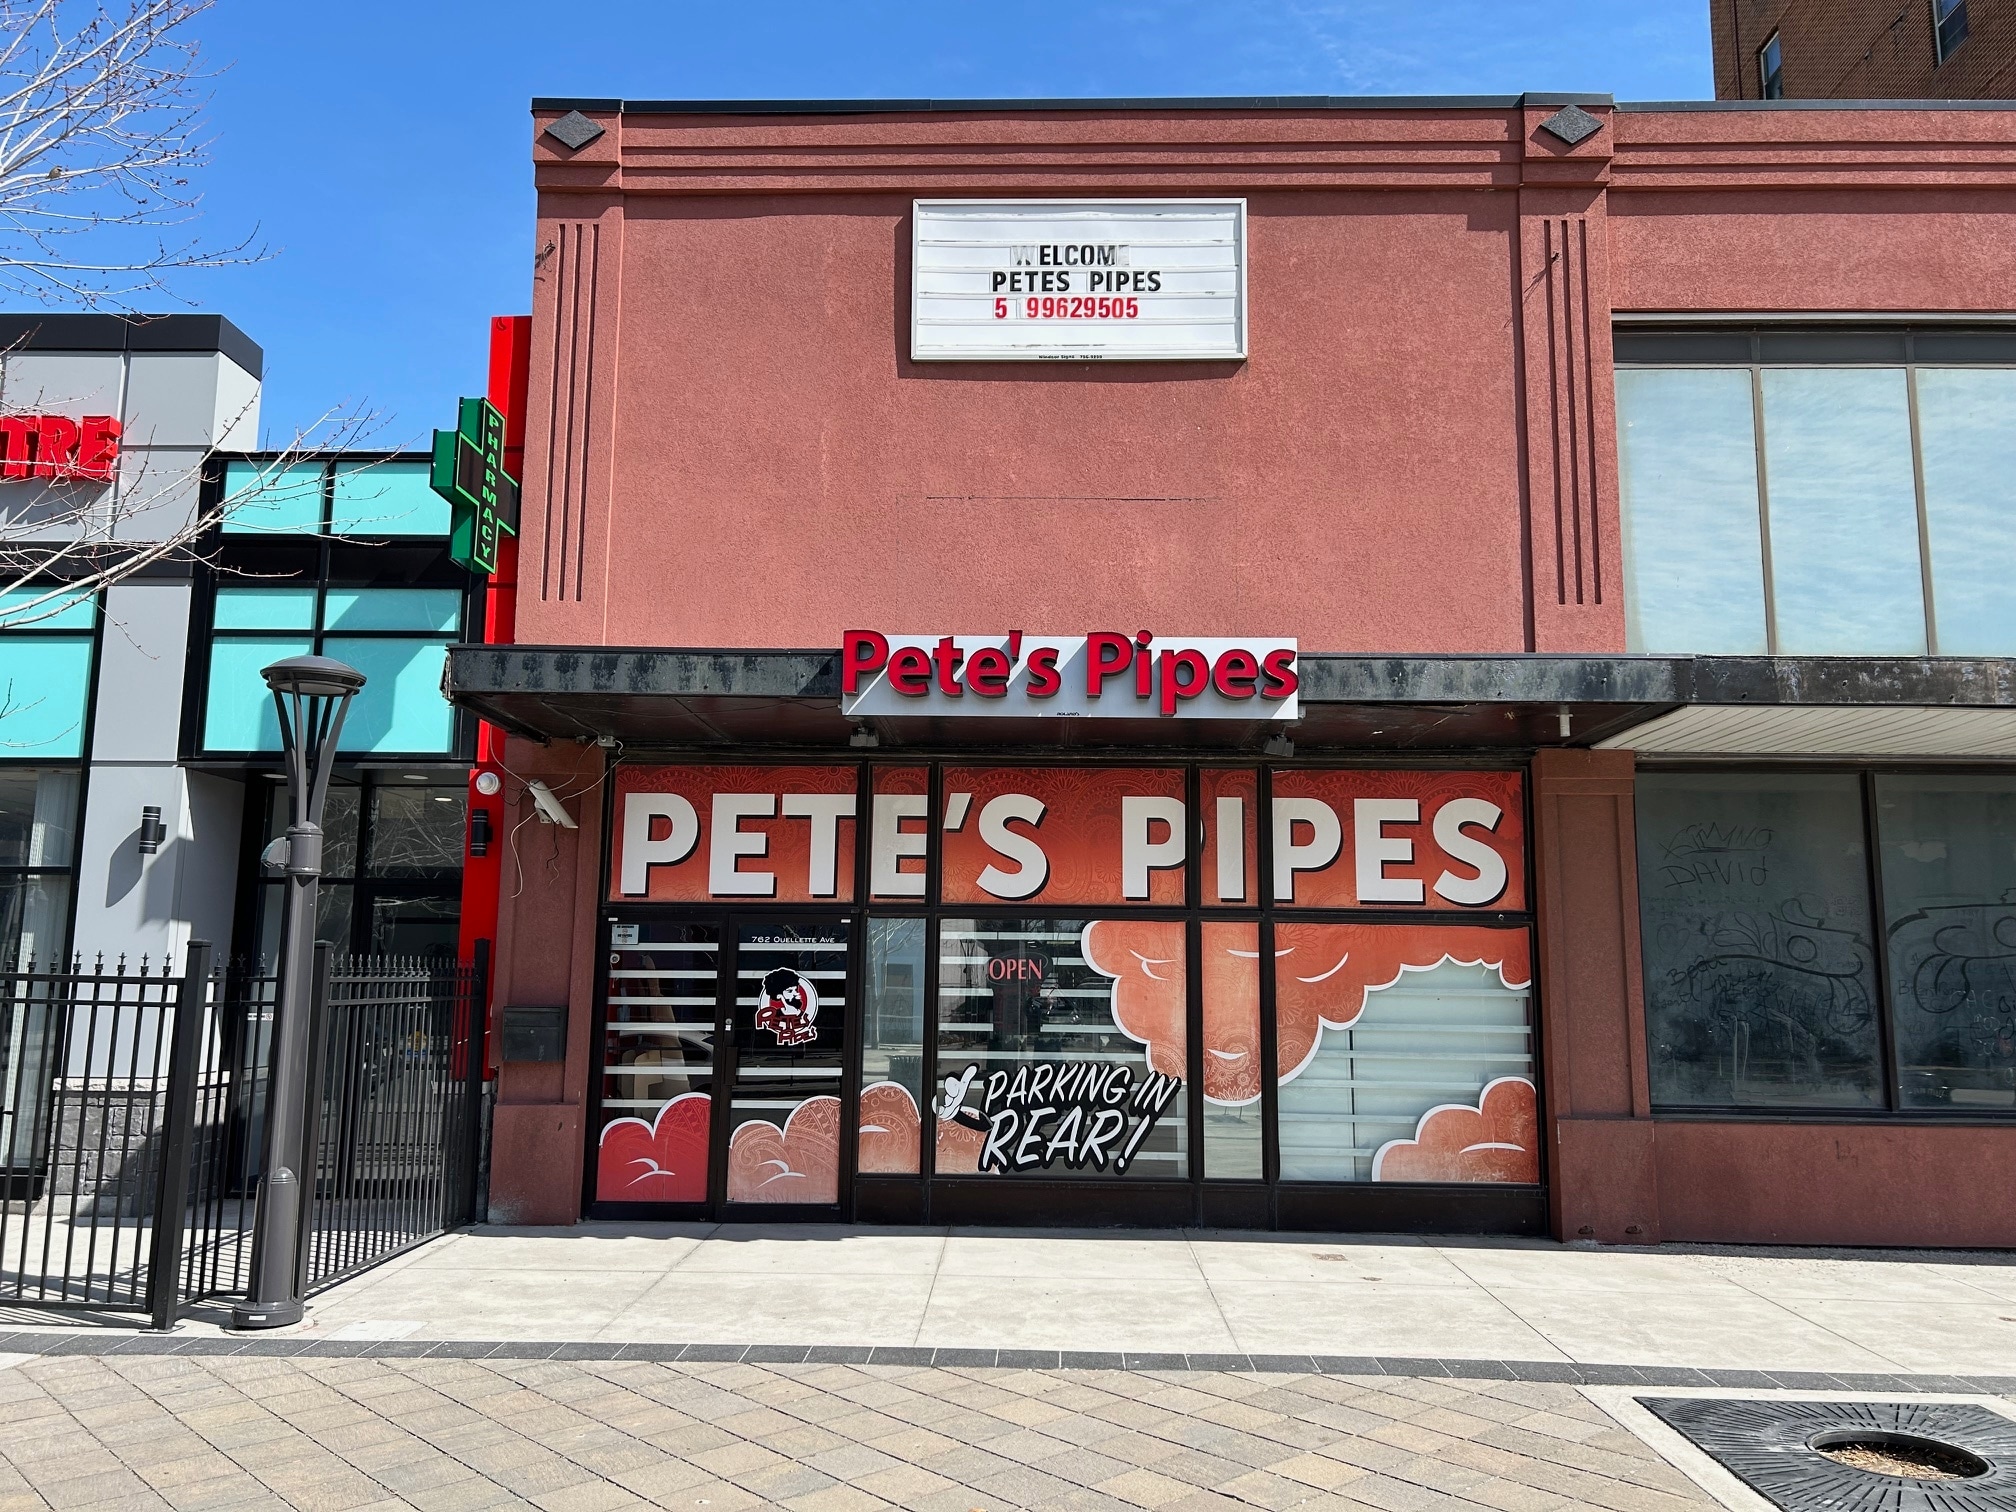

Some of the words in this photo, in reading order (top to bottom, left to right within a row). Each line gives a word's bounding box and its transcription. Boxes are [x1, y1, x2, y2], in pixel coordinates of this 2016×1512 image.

[992, 271, 1070, 292] PETES
[1090, 271, 1162, 292] PIPES
[1012, 245, 1129, 266] WELCOM
[481, 412, 500, 560] PHARMACY
[842, 629, 1062, 698] Pete's
[1086, 629, 1300, 718] Pipes
[620, 792, 1049, 899] PETE'S
[1121, 795, 1508, 904] PIPES
[989, 958, 1043, 980] OPEN
[984, 1063, 1131, 1112] PARKING
[1133, 1073, 1180, 1113] IN
[981, 1105, 1151, 1169] REAR!
